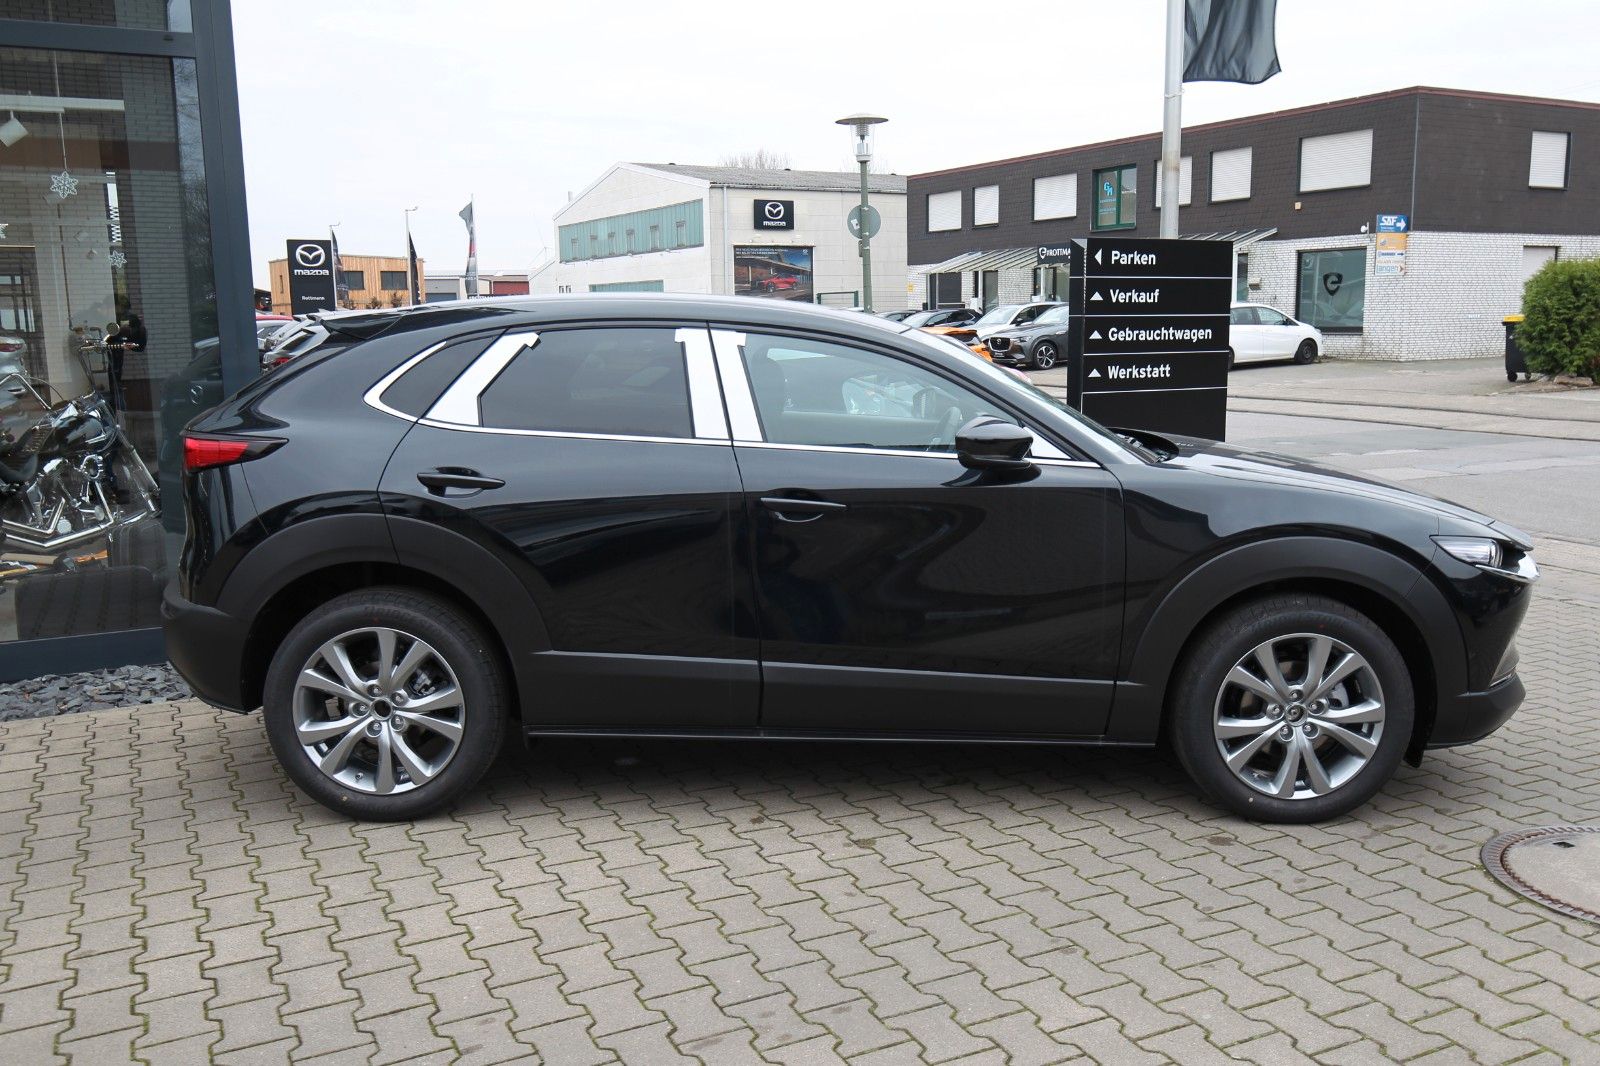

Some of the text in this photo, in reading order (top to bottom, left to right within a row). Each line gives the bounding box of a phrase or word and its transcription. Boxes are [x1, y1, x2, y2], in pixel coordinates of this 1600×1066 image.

[1111, 250, 1156, 265] Parken
[1110, 289, 1160, 303] Verkauf
[1108, 326, 1212, 343] Gebrauchtwagen
[1107, 364, 1171, 379] Werkstatt
